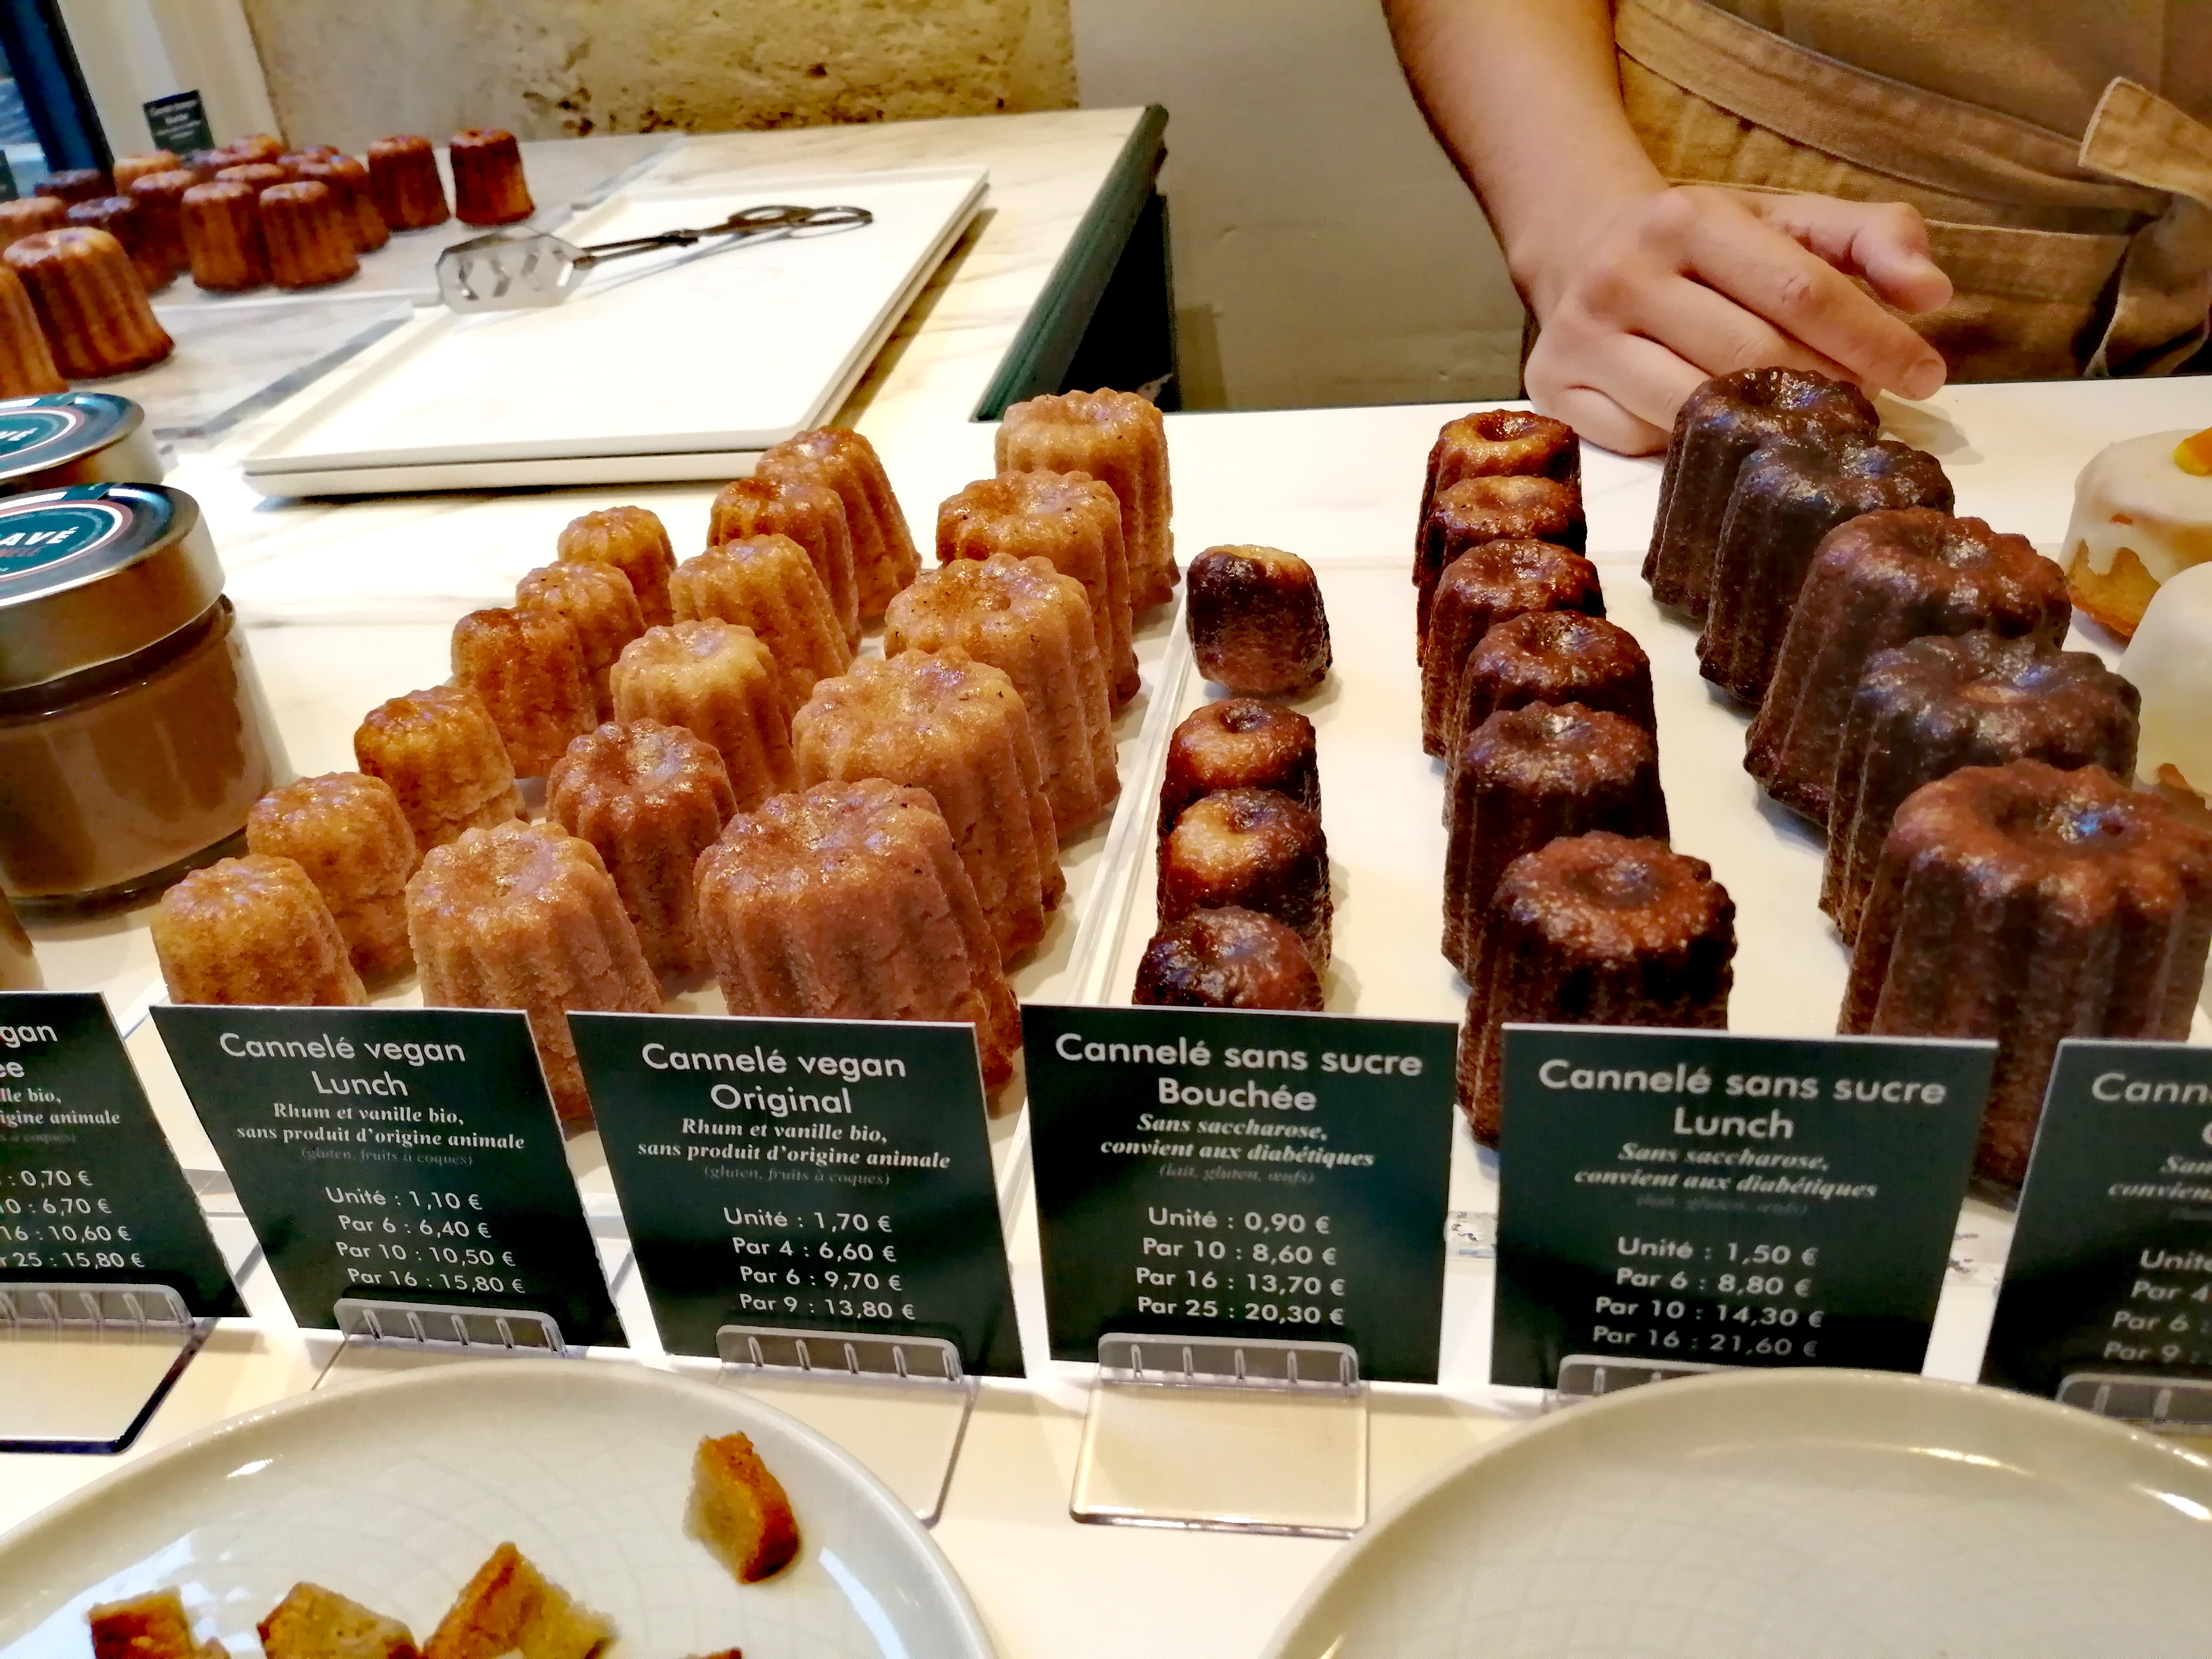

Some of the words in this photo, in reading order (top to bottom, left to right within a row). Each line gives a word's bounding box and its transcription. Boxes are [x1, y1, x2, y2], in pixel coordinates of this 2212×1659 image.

[220, 1032, 355, 1059] Cannelé
[363, 1043, 466, 1067] vegan
[1055, 1033, 1211, 1066] Cannelé
[1224, 1048, 1308, 1071] sans
[1320, 1052, 1423, 1077] sucre
[642, 1043, 787, 1074] Cannelé
[797, 1056, 906, 1083] vegan
[311, 1070, 408, 1096] Lunch
[1158, 1077, 1317, 1111] Bouchée
[1538, 1059, 1712, 1094] Cannelé
[1725, 1071, 1819, 1100] sans
[1833, 1079, 1947, 1105] sucre
[2091, 1072, 2212, 1103] Cann
[27, 1088, 61, 1104] bio,
[710, 1084, 852, 1118] Original
[49, 1110, 120, 1124] animale
[273, 1103, 330, 1119] Rhum
[337, 1108, 352, 1119] et
[358, 1106, 422, 1122] vanille
[429, 1107, 464, 1125] bio,
[1136, 1113, 1192, 1133] Sans
[1196, 1118, 1327, 1141] saccharose,
[1673, 1107, 1794, 1139] Lunch
[237, 1128, 277, 1138] sans
[283, 1126, 350, 1143] produit
[448, 1132, 525, 1149] animale
[682, 1117, 742, 1136] Rhum
[750, 1124, 767, 1137] et
[774, 1123, 843, 1140] vanille
[849, 1125, 887, 1143] bio,
[638, 1144, 681, 1156] sans
[687, 1143, 760, 1161] produit
[866, 1150, 951, 1169] animale
[1100, 1138, 1195, 1158] convient
[1199, 1146, 1242, 1160] aux
[1246, 1143, 1374, 1169] diabétiques
[1618, 1142, 1678, 1161] Sans
[1683, 1146, 1829, 1172] saccharose,
[20, 1170, 72, 1189] 0,70
[78, 1170, 93, 1186] €
[1574, 1168, 1679, 1187] convient
[1683, 1176, 1732, 1191] aux
[1736, 1174, 1877, 1200] diabétiques
[43, 1198, 91, 1217] 6,70
[97, 1198, 112, 1214] €
[325, 1186, 387, 1205] Unité
[408, 1191, 460, 1210] 1,10
[468, 1194, 483, 1210] €
[338, 1215, 374, 1231] Par
[382, 1217, 396, 1233] 6
[419, 1219, 470, 1238] 6,40
[477, 1222, 492, 1238] €
[723, 1207, 788, 1227] Unité
[814, 1212, 869, 1233] 1,70
[877, 1215, 892, 1233] €
[1149, 1206, 1218, 1228] Unité
[1244, 1211, 1306, 1234] 0,90
[1315, 1216, 1329, 1235] €
[0, 1225, 29, 1241] 16
[48, 1225, 112, 1243] 10,60
[117, 1226, 132, 1241] €
[12, 1252, 43, 1267] 25
[62, 1252, 125, 1269] 15,80
[130, 1253, 145, 1268] €
[336, 1242, 371, 1258] Par
[378, 1244, 407, 1260] 10
[429, 1246, 495, 1267] 10,50
[501, 1251, 516, 1267] €
[732, 1237, 770, 1255] Par
[779, 1240, 794, 1256] 4
[819, 1242, 874, 1262] 6,60
[882, 1245, 896, 1262] €
[1143, 1237, 1184, 1257] Par
[1194, 1240, 1226, 1259] 10
[1252, 1243, 1313, 1266] 8,60
[1321, 1247, 1336, 1266] €
[1618, 1236, 1693, 1259] Unité
[1728, 1242, 1792, 1264] 1,50
[1801, 1247, 1818, 1266] €
[347, 1268, 382, 1284] Par
[389, 1270, 418, 1287] 16
[439, 1273, 504, 1293] 15,80
[511, 1278, 526, 1294] €
[740, 1266, 777, 1283] Par
[786, 1268, 800, 1285] 6
[824, 1271, 879, 1291] 9,70
[888, 1275, 902, 1291] €
[1136, 1267, 1176, 1286] Par
[1187, 1270, 1218, 1289] 16
[1247, 1273, 1321, 1295] 13,70
[1330, 1278, 1345, 1296] €
[1616, 1267, 1662, 1287] Par
[1670, 1271, 1688, 1289] 6
[1717, 1273, 1784, 1295] 8,80
[1794, 1278, 1812, 1297] €
[2131, 1280, 2181, 1301] Par
[740, 1293, 776, 1310] Par
[783, 1296, 798, 1312] 9
[825, 1298, 893, 1319] 13,80
[901, 1304, 916, 1320] €
[1138, 1296, 1177, 1314] Par
[1185, 1299, 1218, 1318] 25
[1244, 1302, 1321, 1325] 20,30
[1329, 1308, 1344, 1326] €
[1595, 1296, 1639, 1315] Par
[1652, 1300, 1685, 1319] 10
[1717, 1304, 1799, 1327] 14,30
[1808, 1310, 1824, 1328] €
[2112, 1310, 2160, 1330] Par
[2168, 1314, 2190, 1332] 6
[1593, 1325, 1635, 1344] Par
[1648, 1329, 1680, 1348] 16
[1710, 1334, 1792, 1355] 21,60
[2104, 1340, 2151, 1361] Par
[2161, 1343, 2182, 1362] 9
